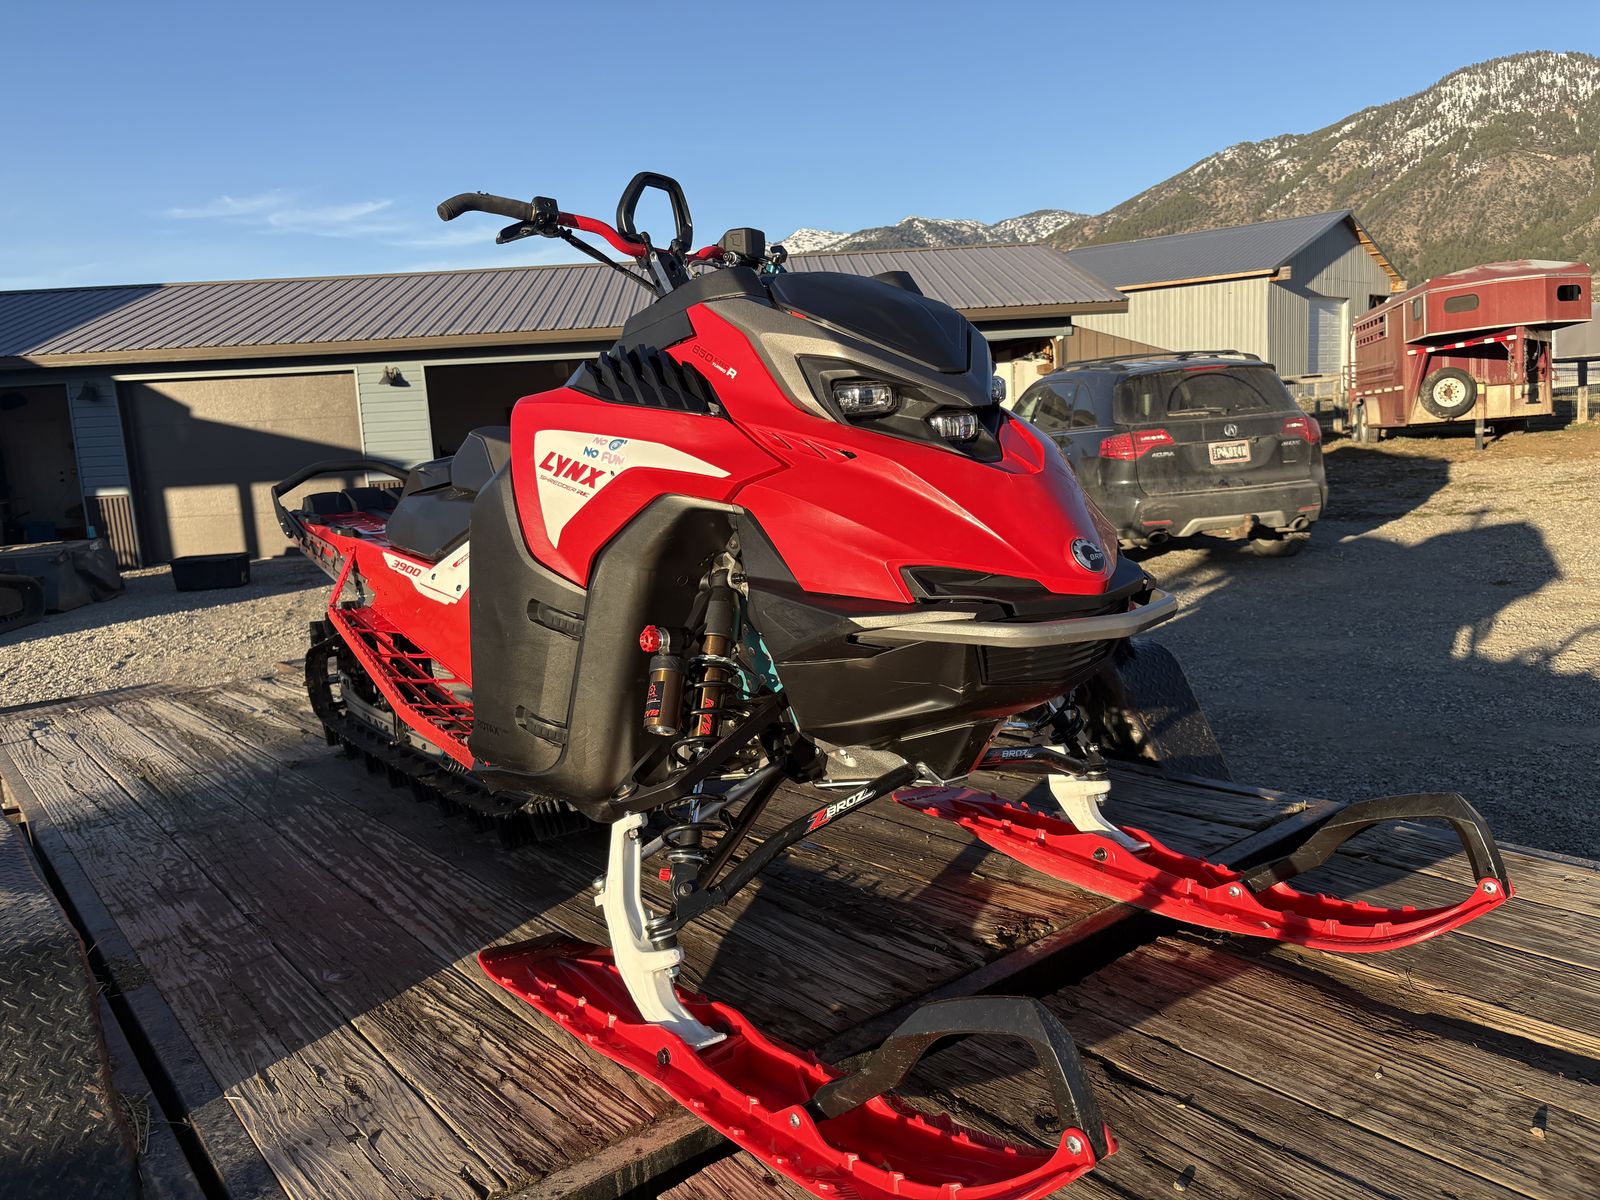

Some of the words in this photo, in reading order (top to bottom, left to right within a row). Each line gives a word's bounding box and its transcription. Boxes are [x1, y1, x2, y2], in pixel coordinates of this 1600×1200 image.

[692, 344, 713, 363] 850
[592, 436, 608, 445] NO
[583, 446, 599, 459] NO
[601, 450, 625, 466] FUN
[539, 451, 607, 490] LYNX
[391, 559, 422, 577] 3900
